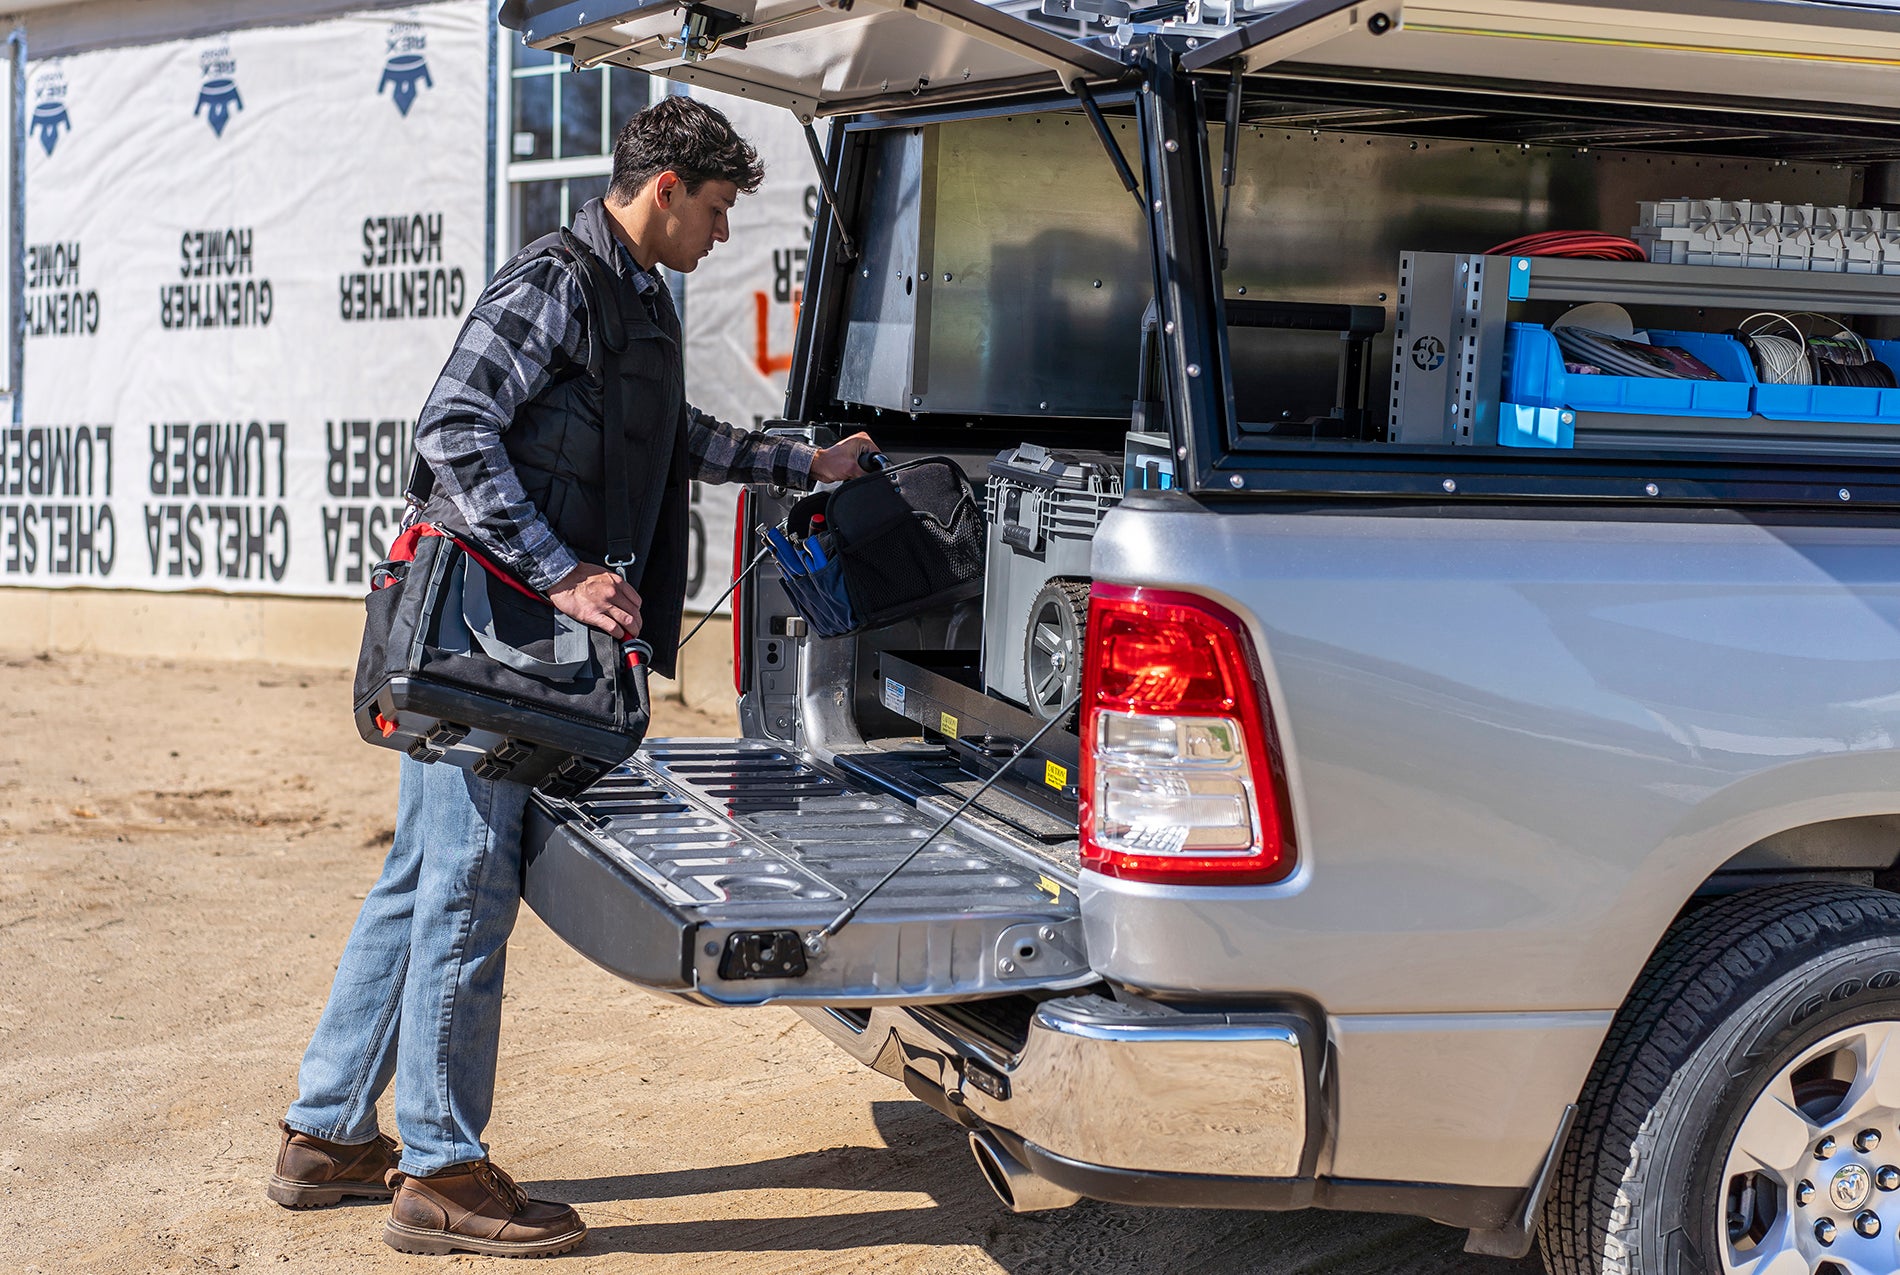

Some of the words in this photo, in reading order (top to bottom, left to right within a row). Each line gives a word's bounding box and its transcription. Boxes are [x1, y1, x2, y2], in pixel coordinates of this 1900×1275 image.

[181, 229, 253, 277] HOMES
[363, 213, 443, 266] HOMES
[29, 243, 79, 288] HOME
[25, 291, 99, 333] GUENTH
[160, 280, 273, 328] GUENTHER
[340, 269, 465, 320] GUENTHER
[150, 423, 287, 497] LUMBER
[0, 504, 115, 576] CHELSE
[145, 505, 289, 582] CHELSEA
